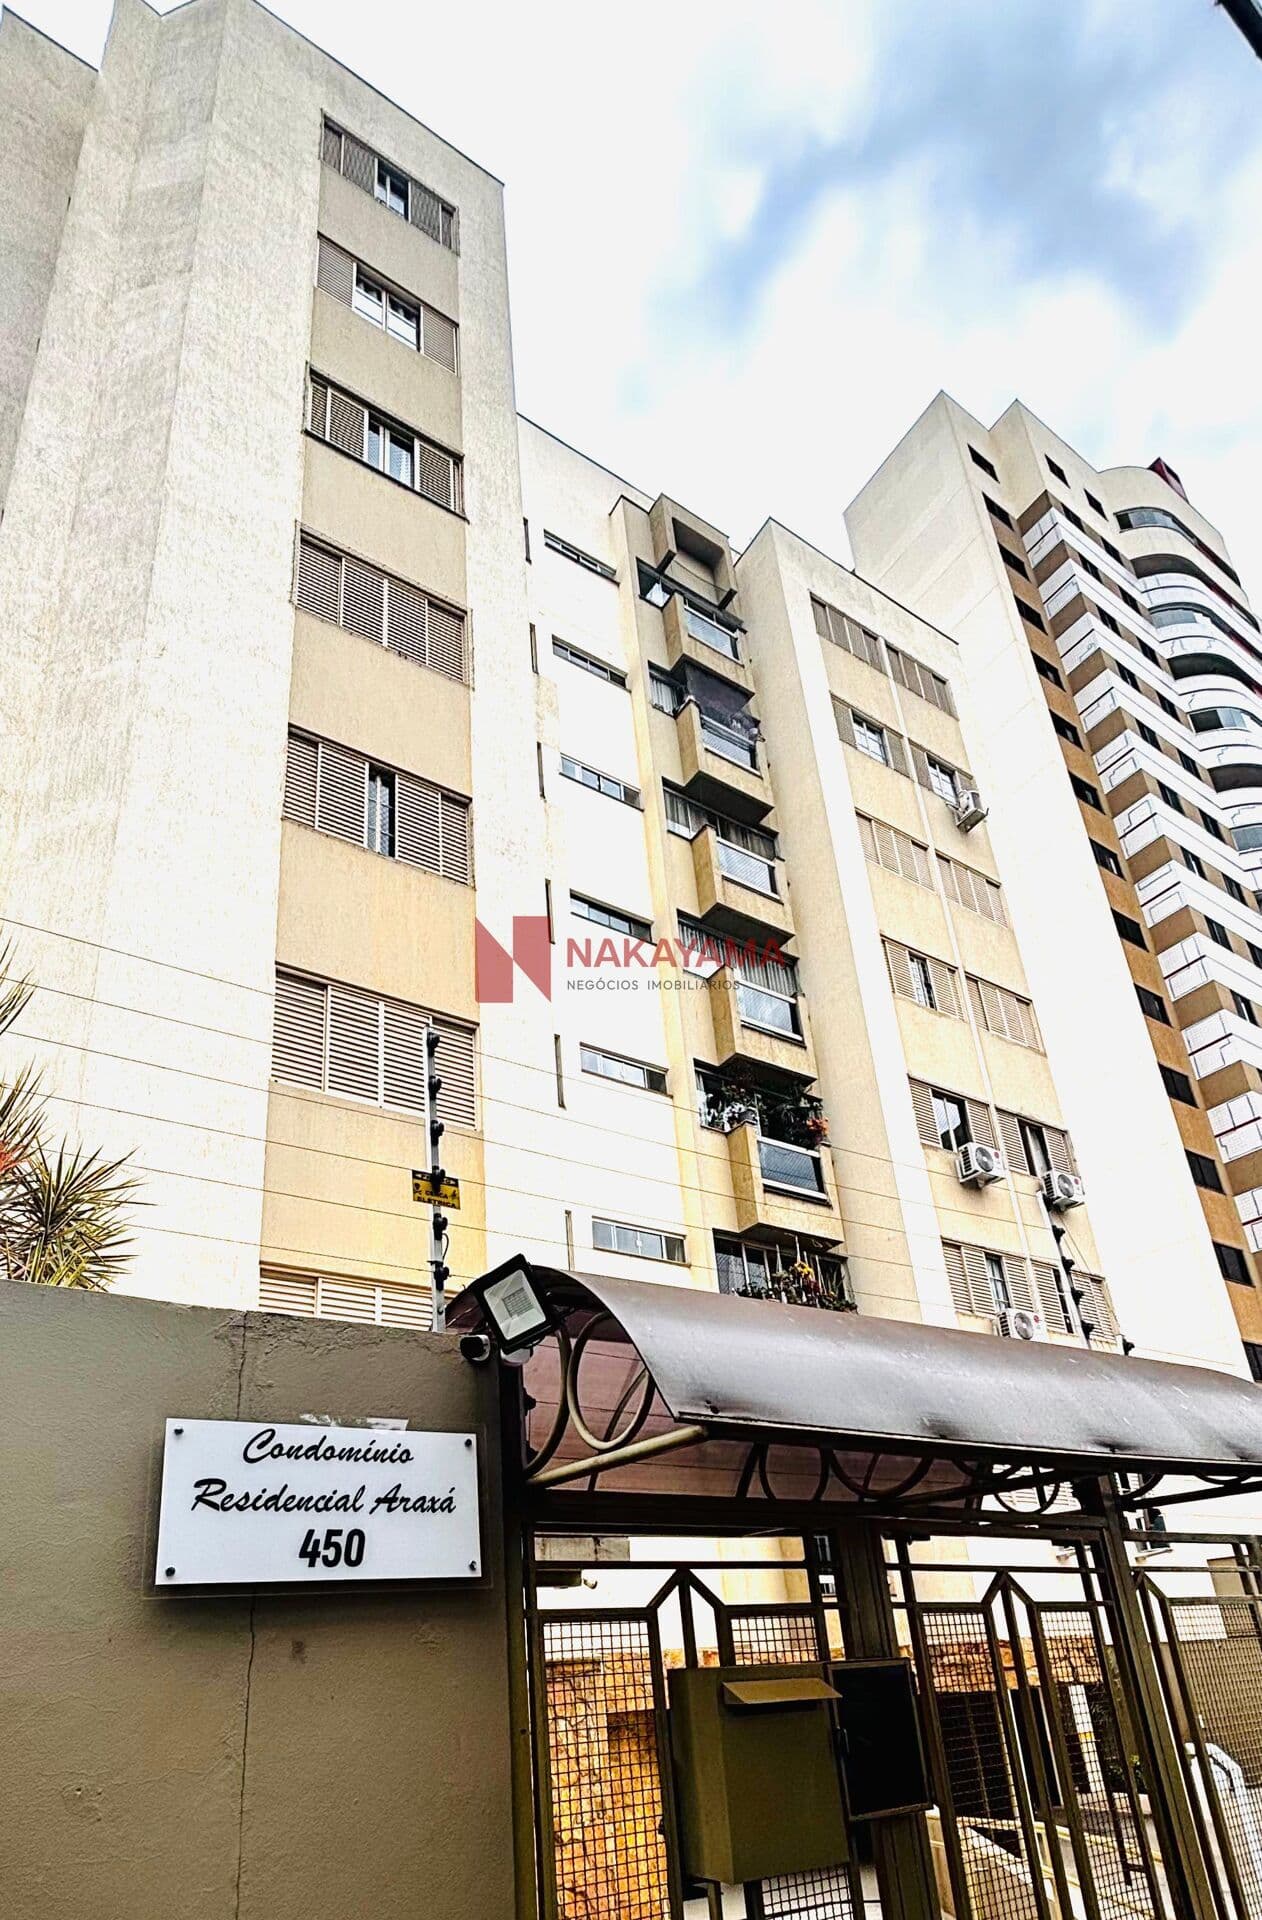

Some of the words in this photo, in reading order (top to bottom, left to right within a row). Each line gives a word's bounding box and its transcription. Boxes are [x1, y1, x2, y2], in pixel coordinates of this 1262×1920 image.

[243, 1428, 414, 1464] Condomínio
[191, 1478, 365, 1513] Residencial
[369, 1483, 456, 1514] Araxá
[299, 1529, 366, 1568] 450
